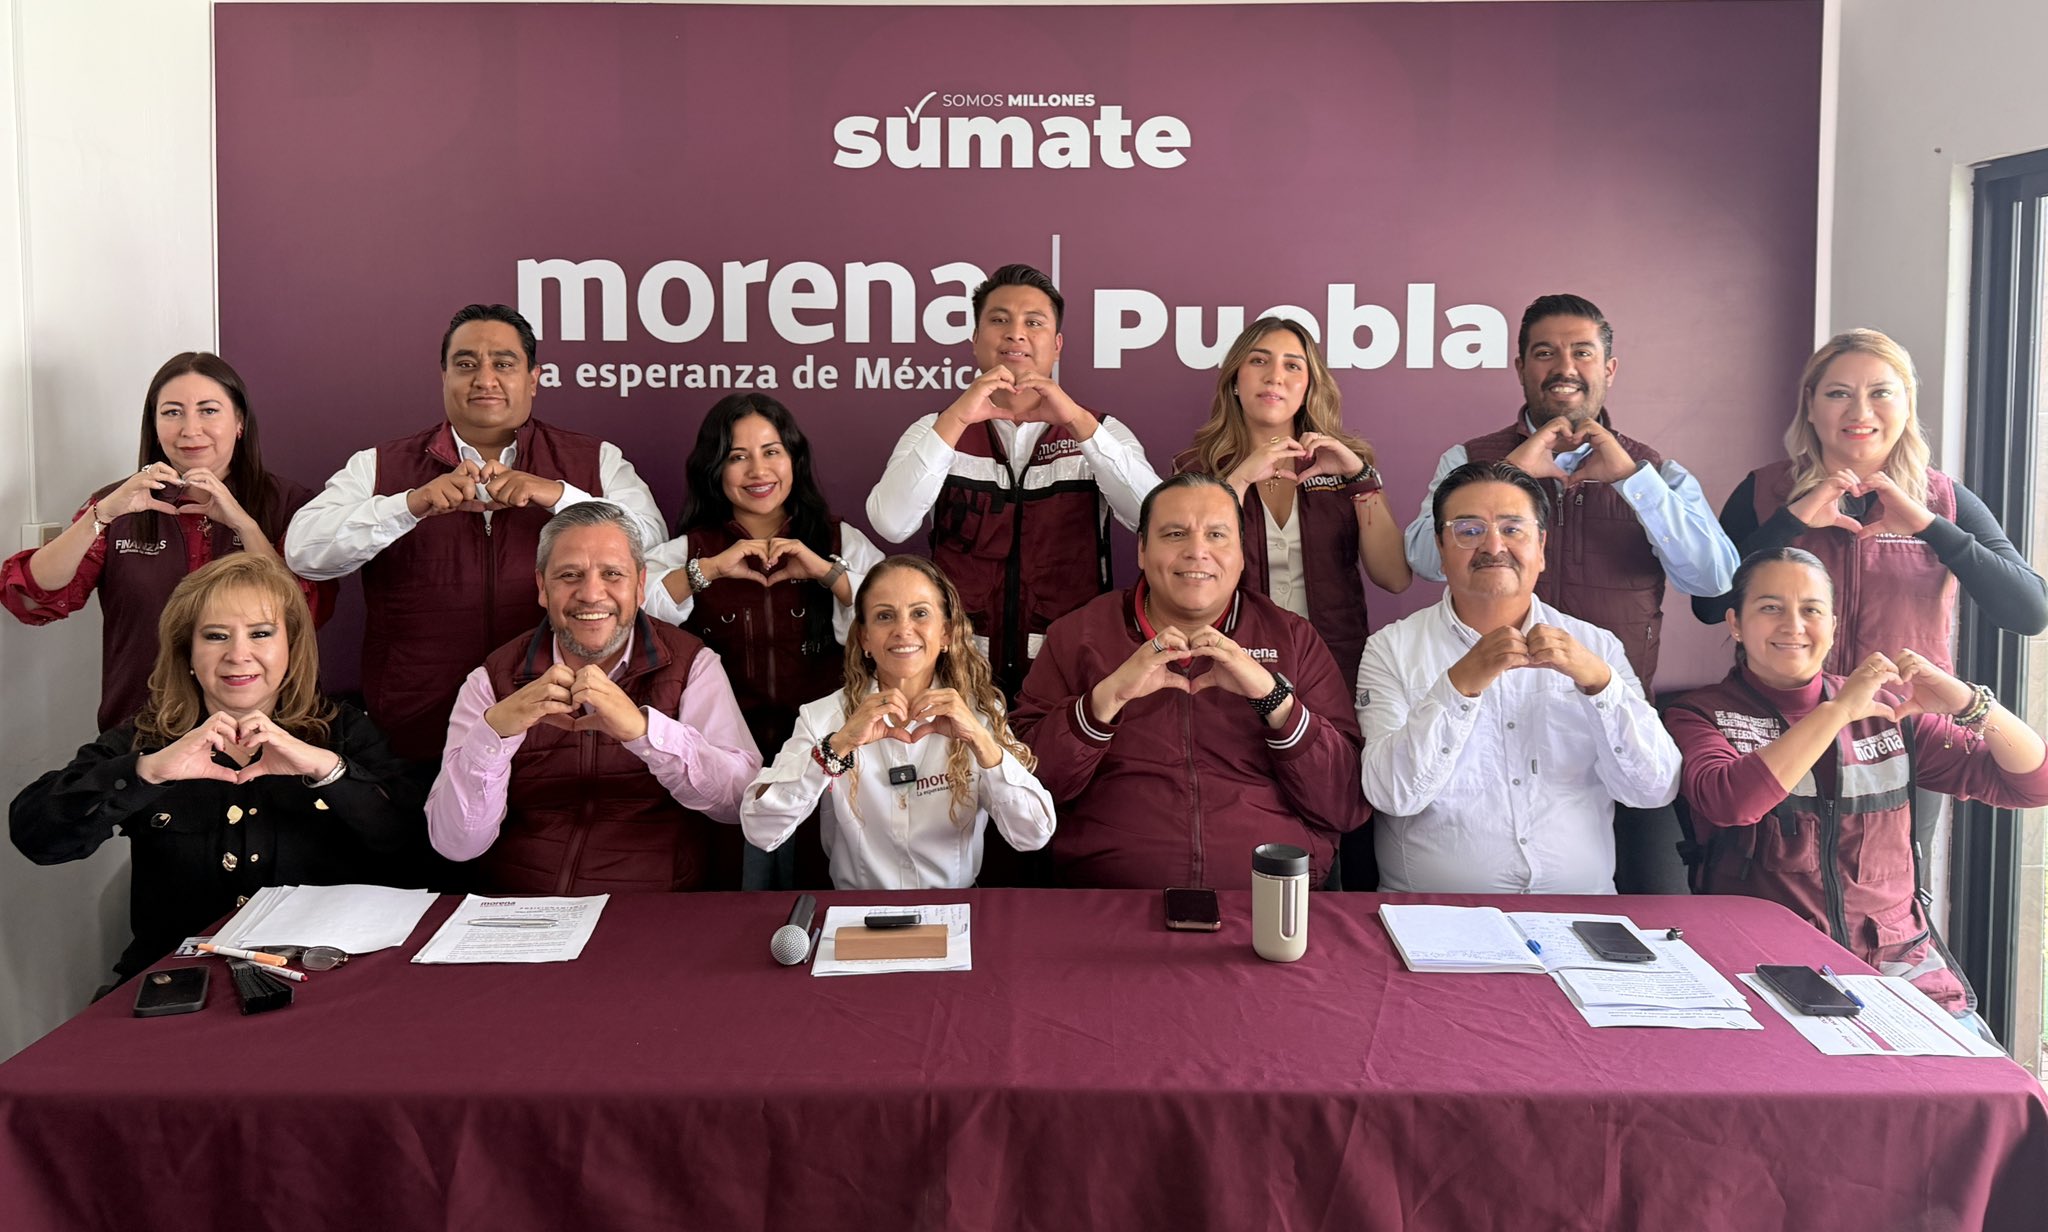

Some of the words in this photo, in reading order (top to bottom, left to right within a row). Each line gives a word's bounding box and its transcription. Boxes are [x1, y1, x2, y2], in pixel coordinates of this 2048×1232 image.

[942, 94, 1003, 107] SOMOS
[1008, 94, 1096, 107] MILLONES
[517, 258, 990, 345] morena
[575, 361, 778, 398] esperanza
[792, 354, 838, 390] de
[855, 357, 982, 390] Méxic
